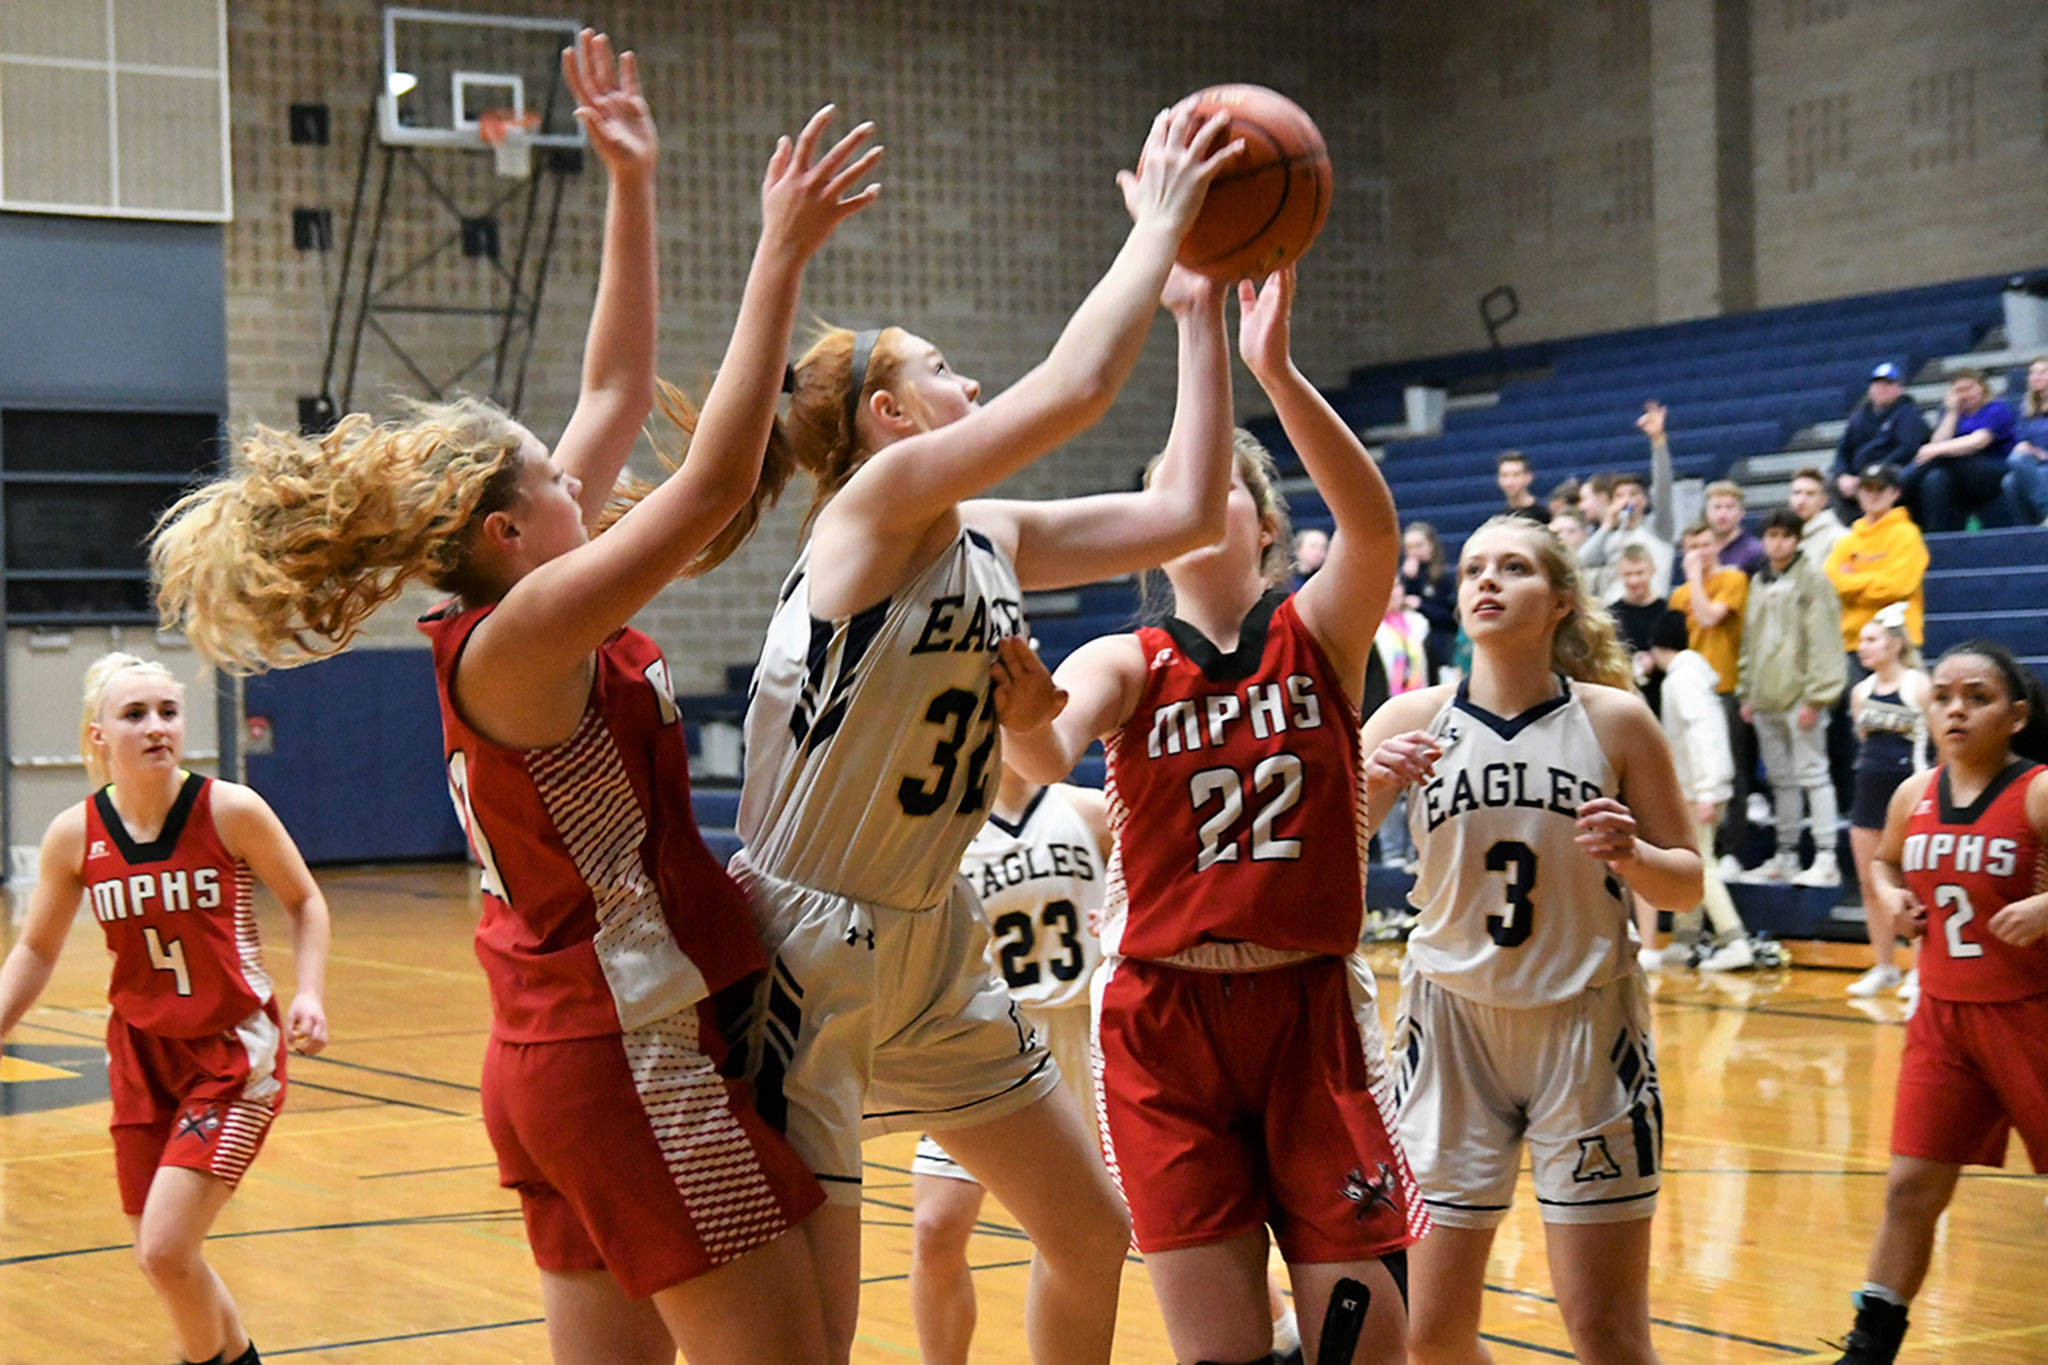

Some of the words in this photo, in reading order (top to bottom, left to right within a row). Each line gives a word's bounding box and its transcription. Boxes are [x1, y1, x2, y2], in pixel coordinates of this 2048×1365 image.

[1147, 673, 1322, 760] MPHS
[1188, 752, 1304, 874] 22
[966, 843, 1095, 900] AGLES
[1902, 833, 2018, 877] MPHS
[92, 867, 221, 922] MPHS
[1485, 840, 1537, 948] 3
[1934, 884, 1984, 959] 2
[142, 926, 193, 997] 4
[993, 899, 1085, 988] 23
[1572, 1133, 1622, 1184] A
[1342, 1299, 1357, 1311] KT
